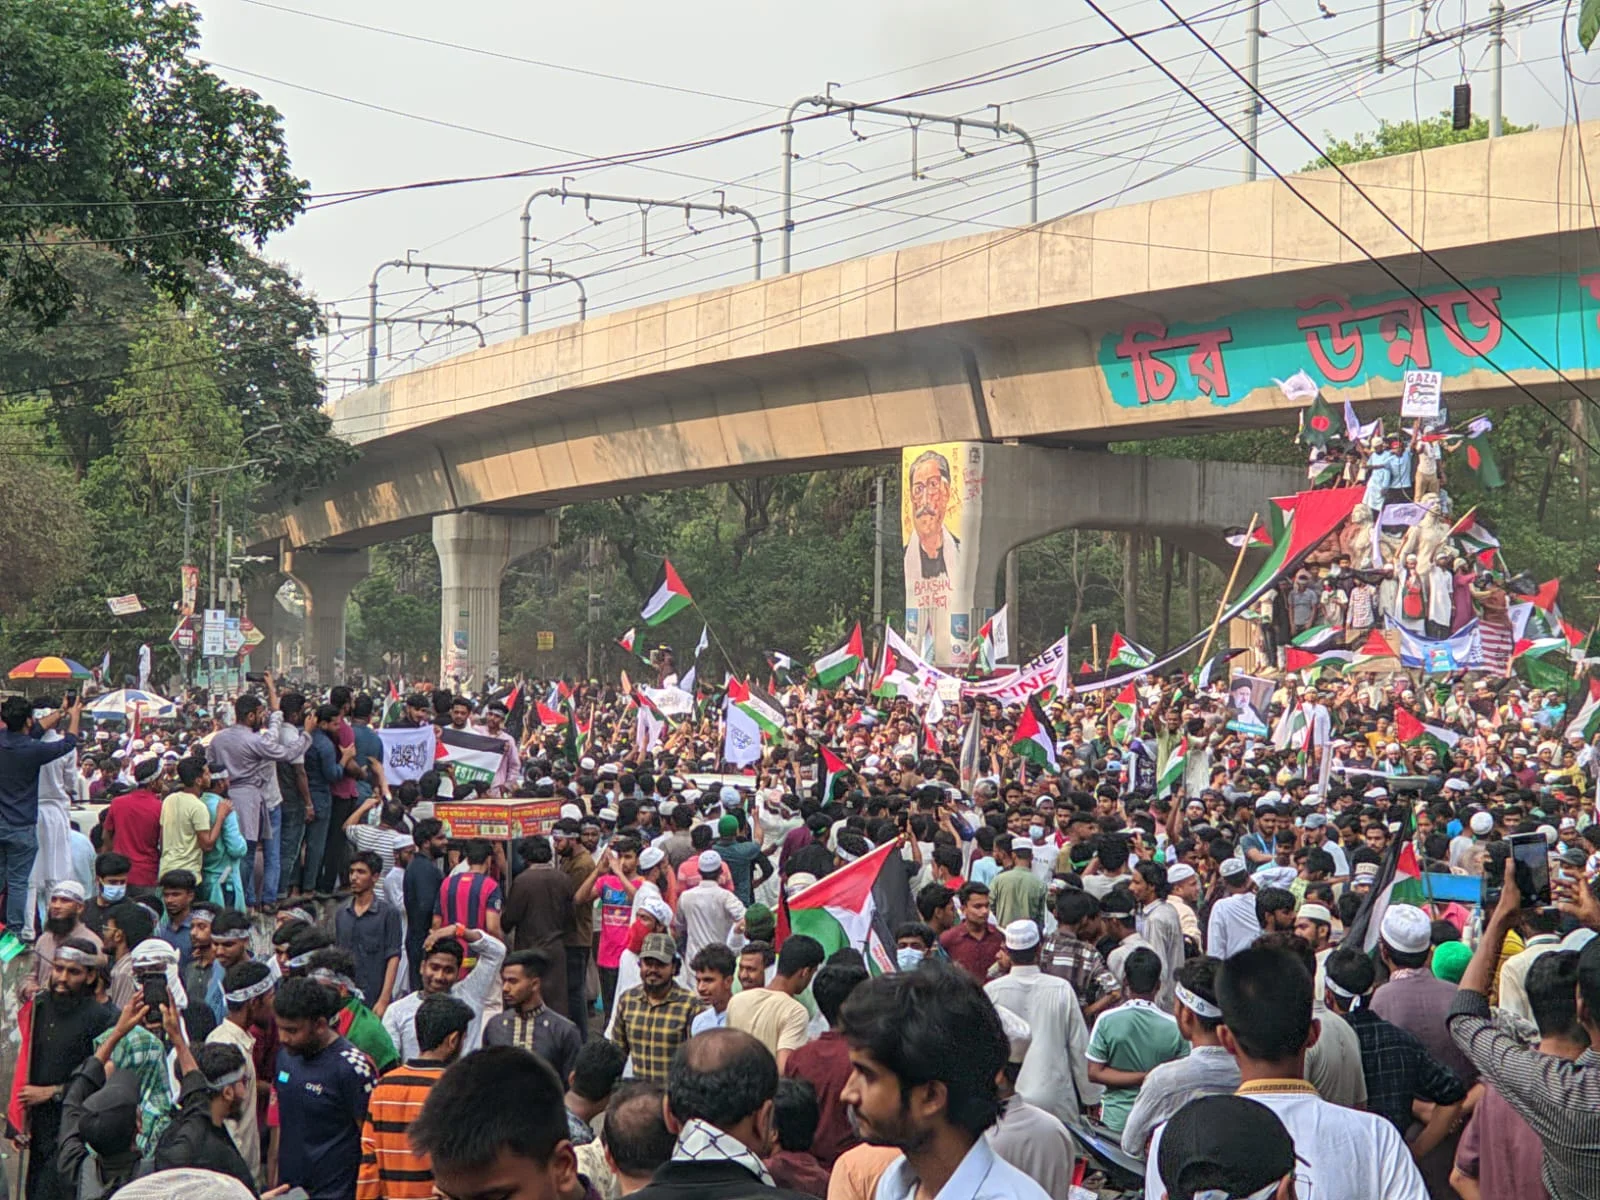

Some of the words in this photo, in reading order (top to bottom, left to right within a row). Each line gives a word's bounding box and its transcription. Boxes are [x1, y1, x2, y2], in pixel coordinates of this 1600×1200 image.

[1116, 321, 1233, 404] চির
[1297, 286, 1503, 383] উন্নত
[1407, 373, 1438, 385] GAZA
[454, 764, 490, 782] ESTINE
